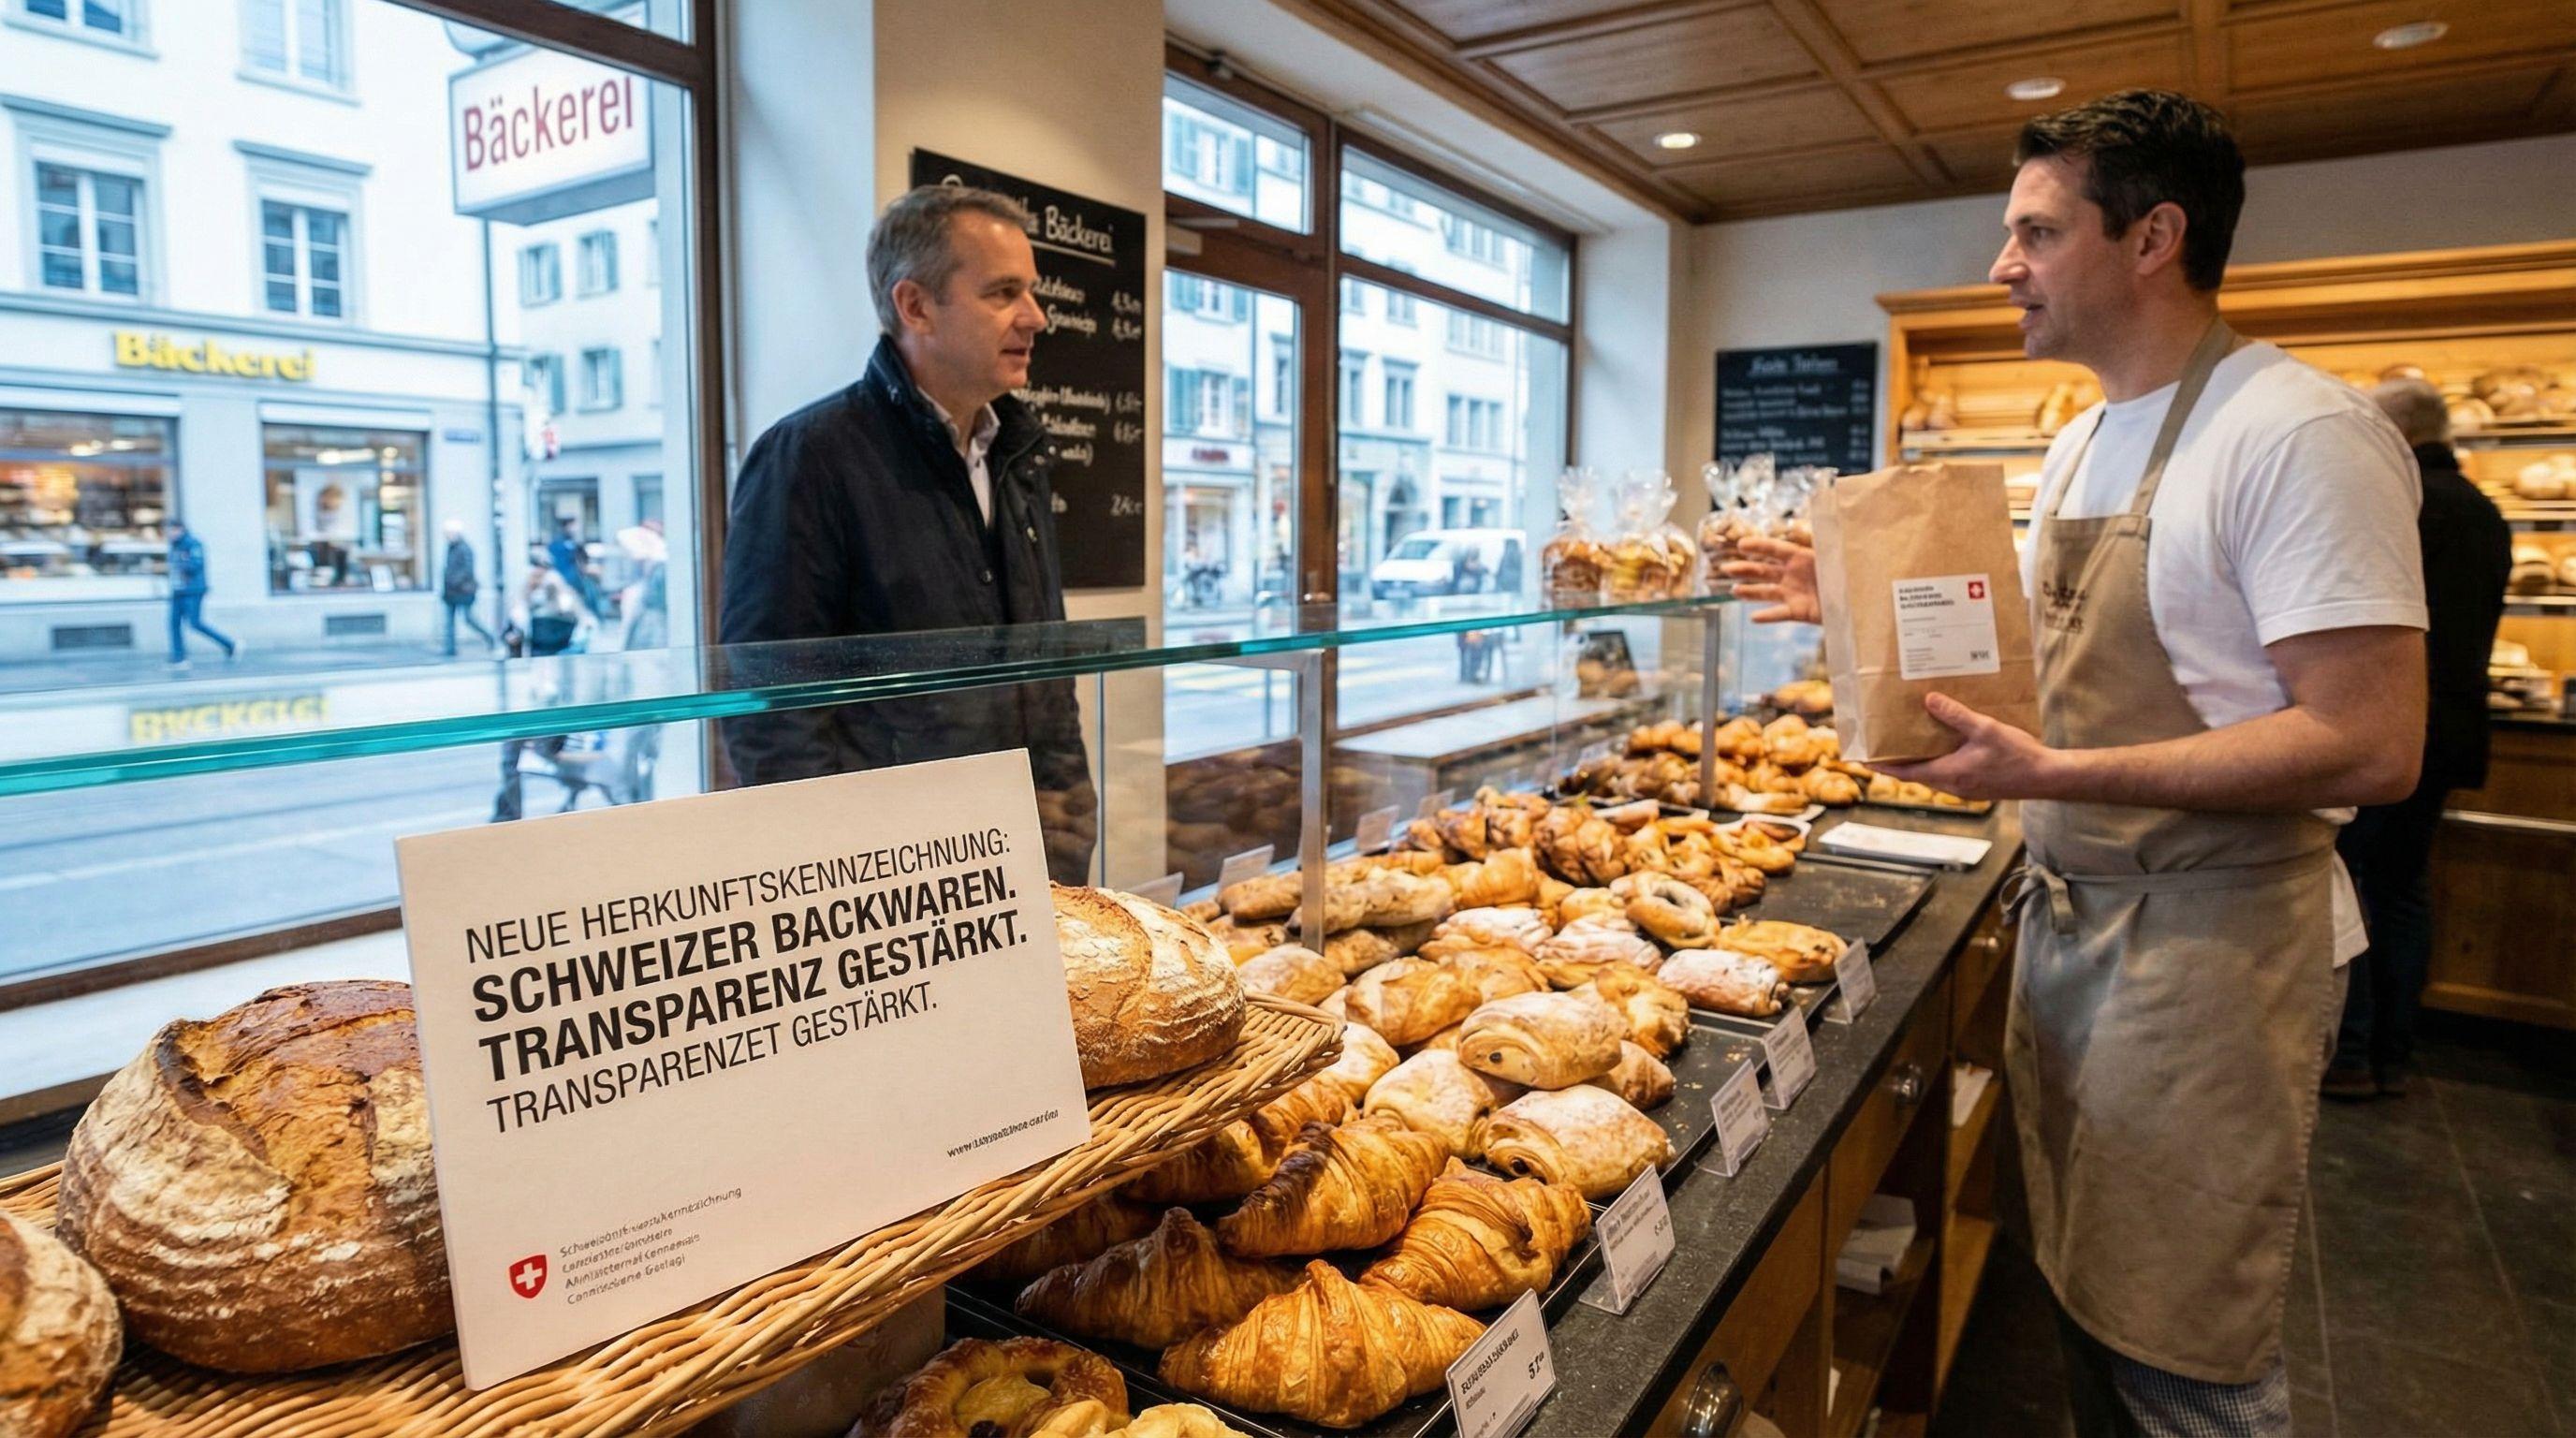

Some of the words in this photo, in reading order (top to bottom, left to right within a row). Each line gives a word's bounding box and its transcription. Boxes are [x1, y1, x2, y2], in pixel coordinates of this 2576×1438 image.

[463, 75, 634, 172] Bäckerei
[1045, 204, 1114, 254] Bäckerei
[113, 330, 316, 382] Bäckerei
[466, 911, 570, 963] NEUE
[582, 829, 1010, 939] HERKUNFTSKENNZEICHNUNG:
[473, 920, 760, 1021] SCHWEIZER
[772, 866, 1017, 953] BACKWAREN.
[479, 957, 827, 1081] TRANSPARENZ
[839, 909, 1027, 989] GESTÄRKT.
[487, 1022, 780, 1133] TRANSPARENZET
[793, 981, 938, 1047] GESTÄRKT.
